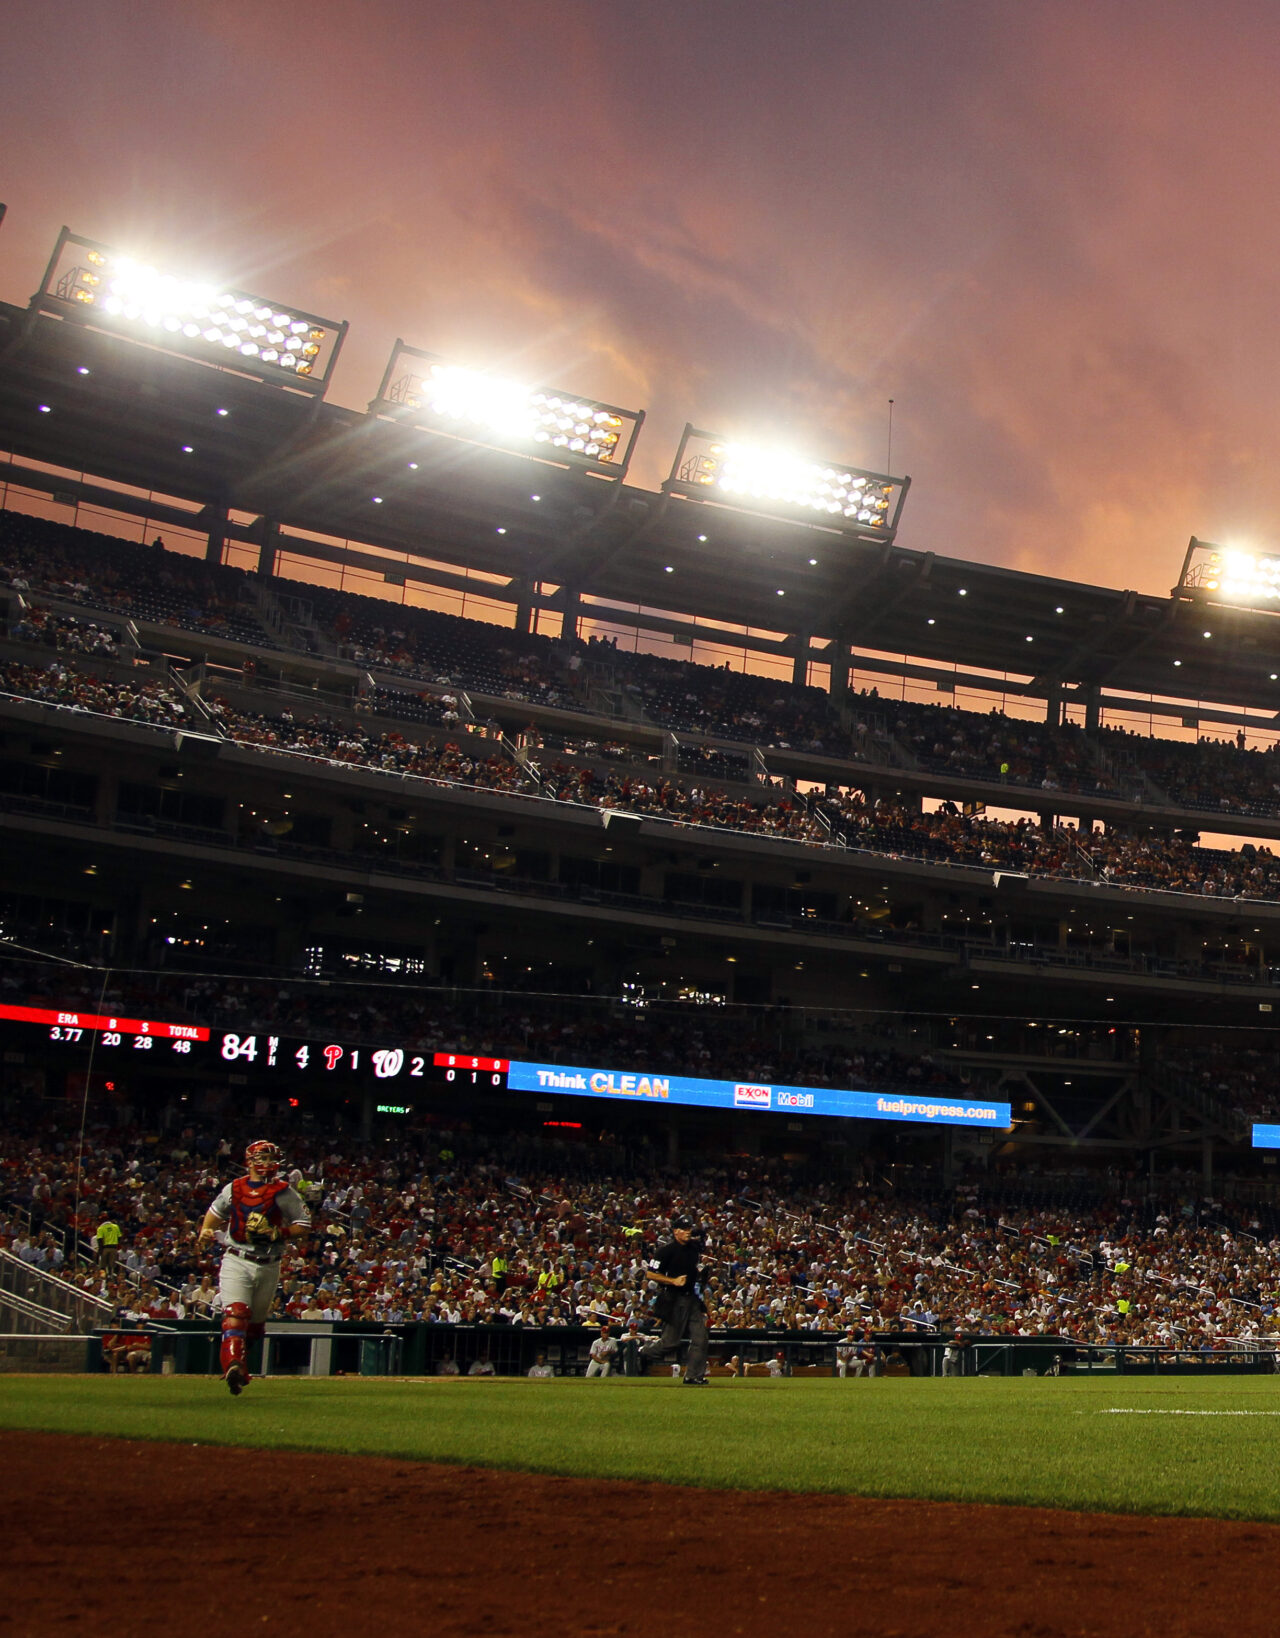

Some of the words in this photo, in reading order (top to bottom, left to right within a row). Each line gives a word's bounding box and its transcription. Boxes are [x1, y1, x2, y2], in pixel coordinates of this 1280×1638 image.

[58, 1013, 79, 1025] ERA
[109, 1019, 117, 1029] B
[142, 1023, 149, 1033] S
[169, 1025, 199, 1039] TOTAL
[50, 1027, 83, 1042] 3.77
[102, 1032, 121, 1046] 20
[134, 1036, 153, 1050] 28
[172, 1040, 192, 1053] 48
[221, 1033, 258, 1062] 84
[267, 1036, 279, 1066] MPH
[295, 1045, 310, 1063] 4
[323, 1044, 343, 1070] P
[350, 1050, 359, 1069] 1
[448, 1055, 456, 1065] B
[471, 1058, 479, 1068] S
[411, 1056, 424, 1076] 2
[446, 1069, 455, 1081] 0
[471, 1071, 477, 1083] 1
[492, 1073, 500, 1085] 0
[537, 1071, 587, 1090] Think
[590, 1073, 669, 1098] CLEAN
[737, 1087, 769, 1099] EXXON
[777, 1092, 814, 1108] Mobil
[876, 1098, 997, 1120] fuelprogress.com
